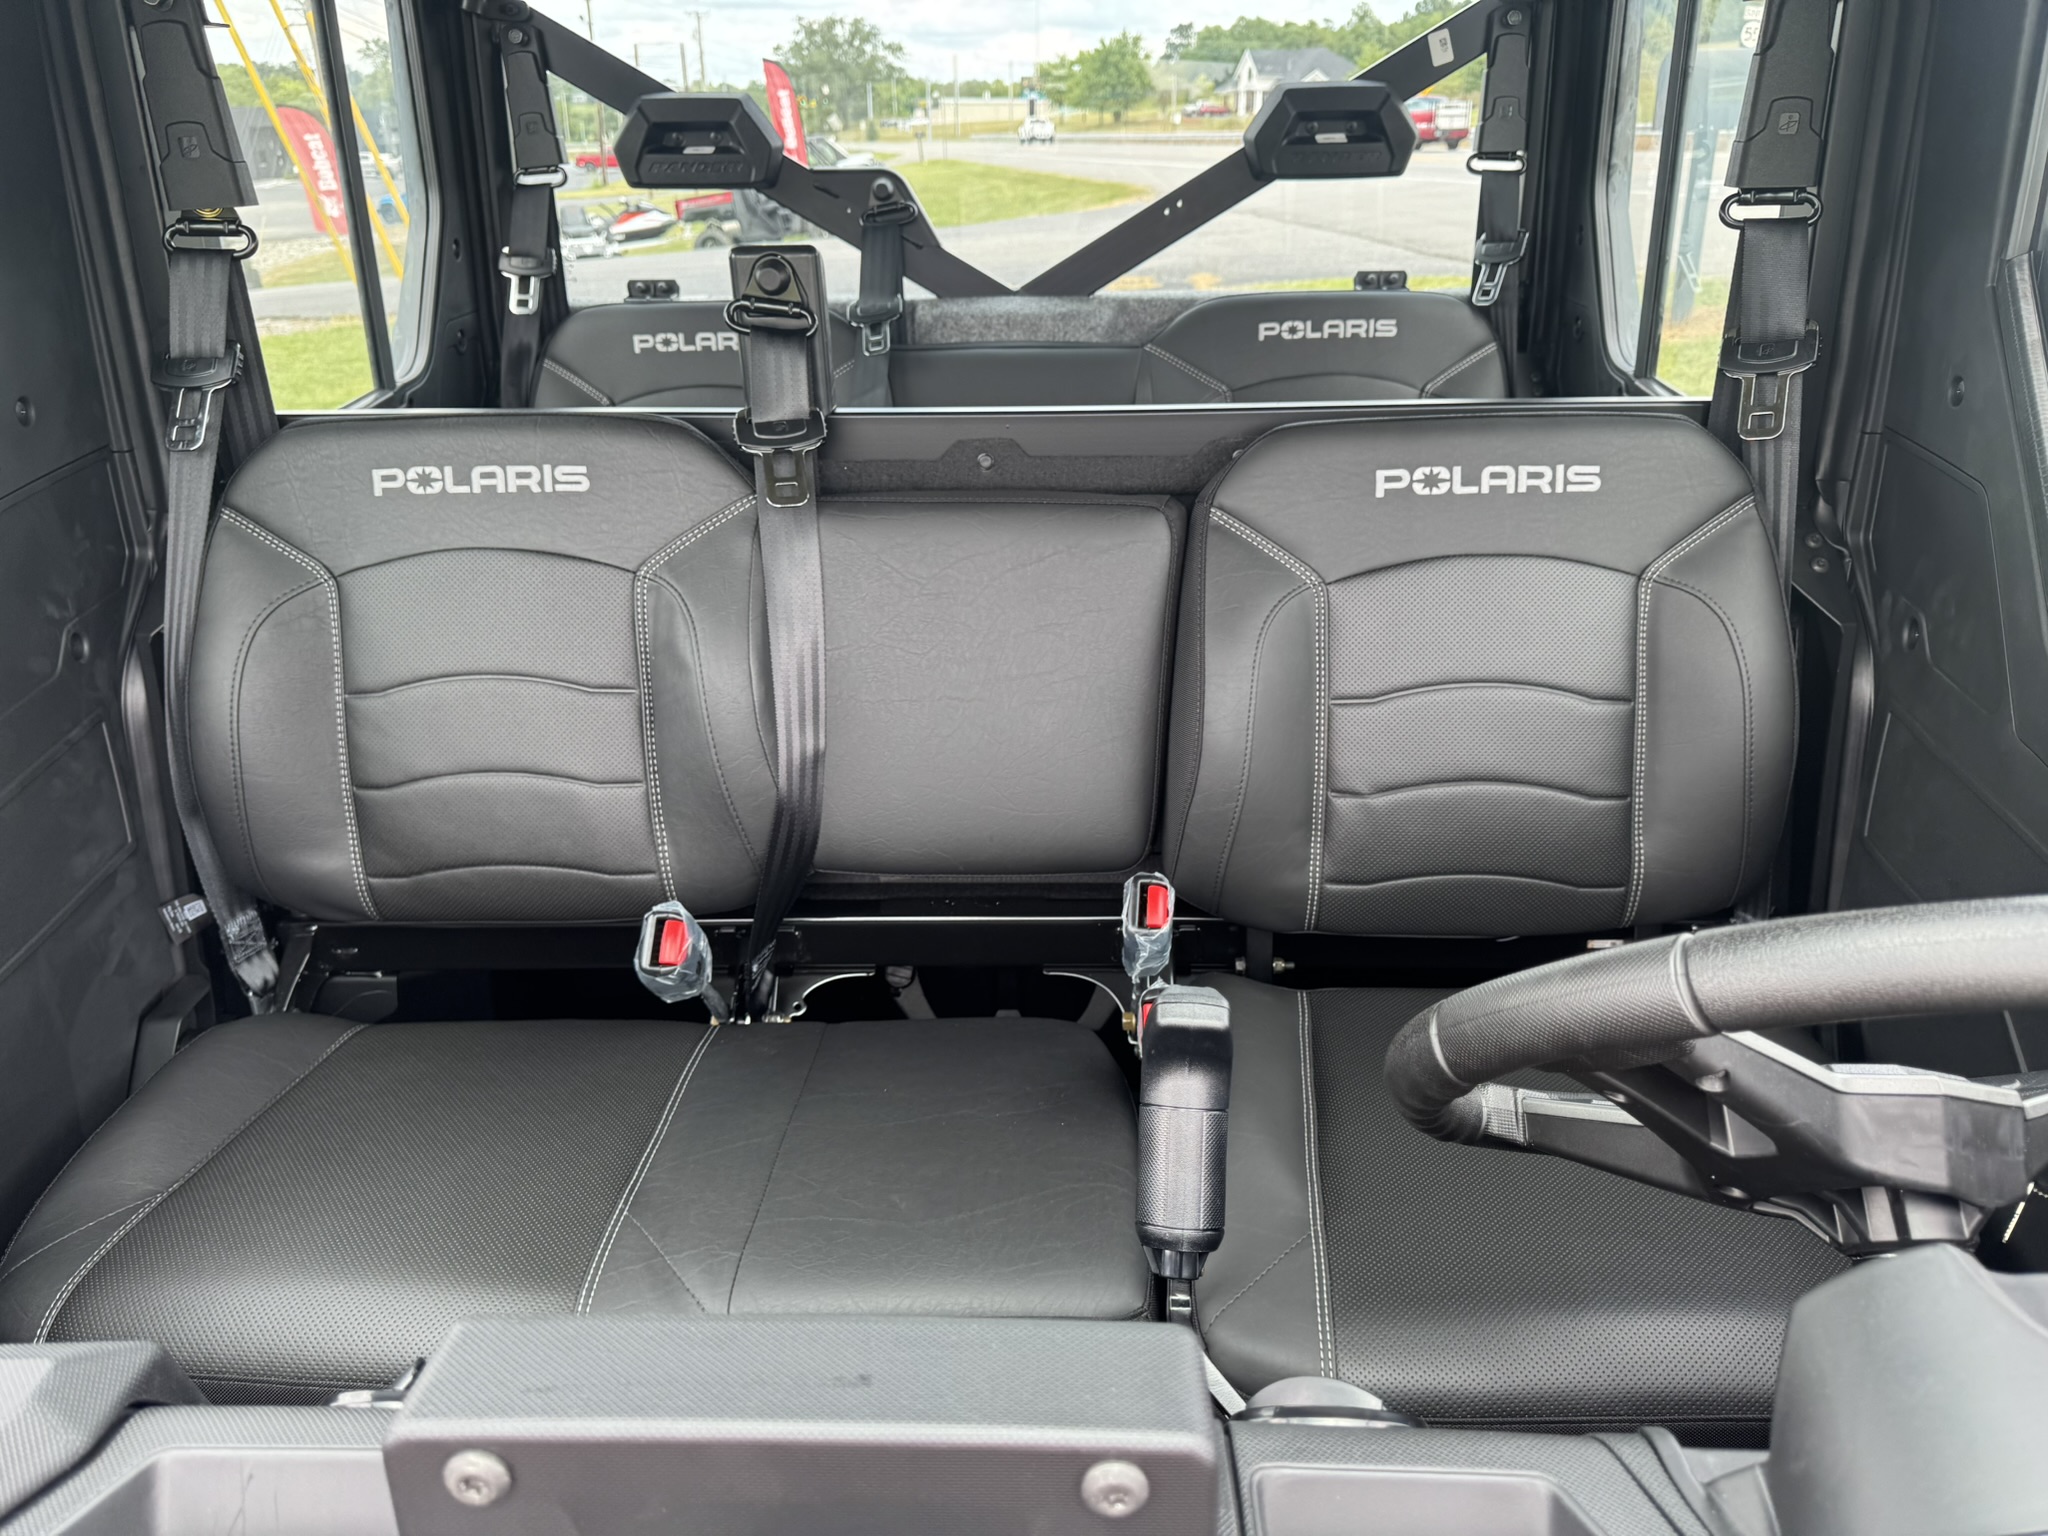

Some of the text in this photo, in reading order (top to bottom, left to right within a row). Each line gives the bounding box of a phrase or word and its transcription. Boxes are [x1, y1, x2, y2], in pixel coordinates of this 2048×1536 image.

[303, 132, 339, 191] Bobcat
[632, 331, 740, 354] POLAR
[1258, 318, 1398, 342] POLARIS
[371, 463, 591, 497] POLARIS
[1374, 463, 1602, 499] POLARIS
